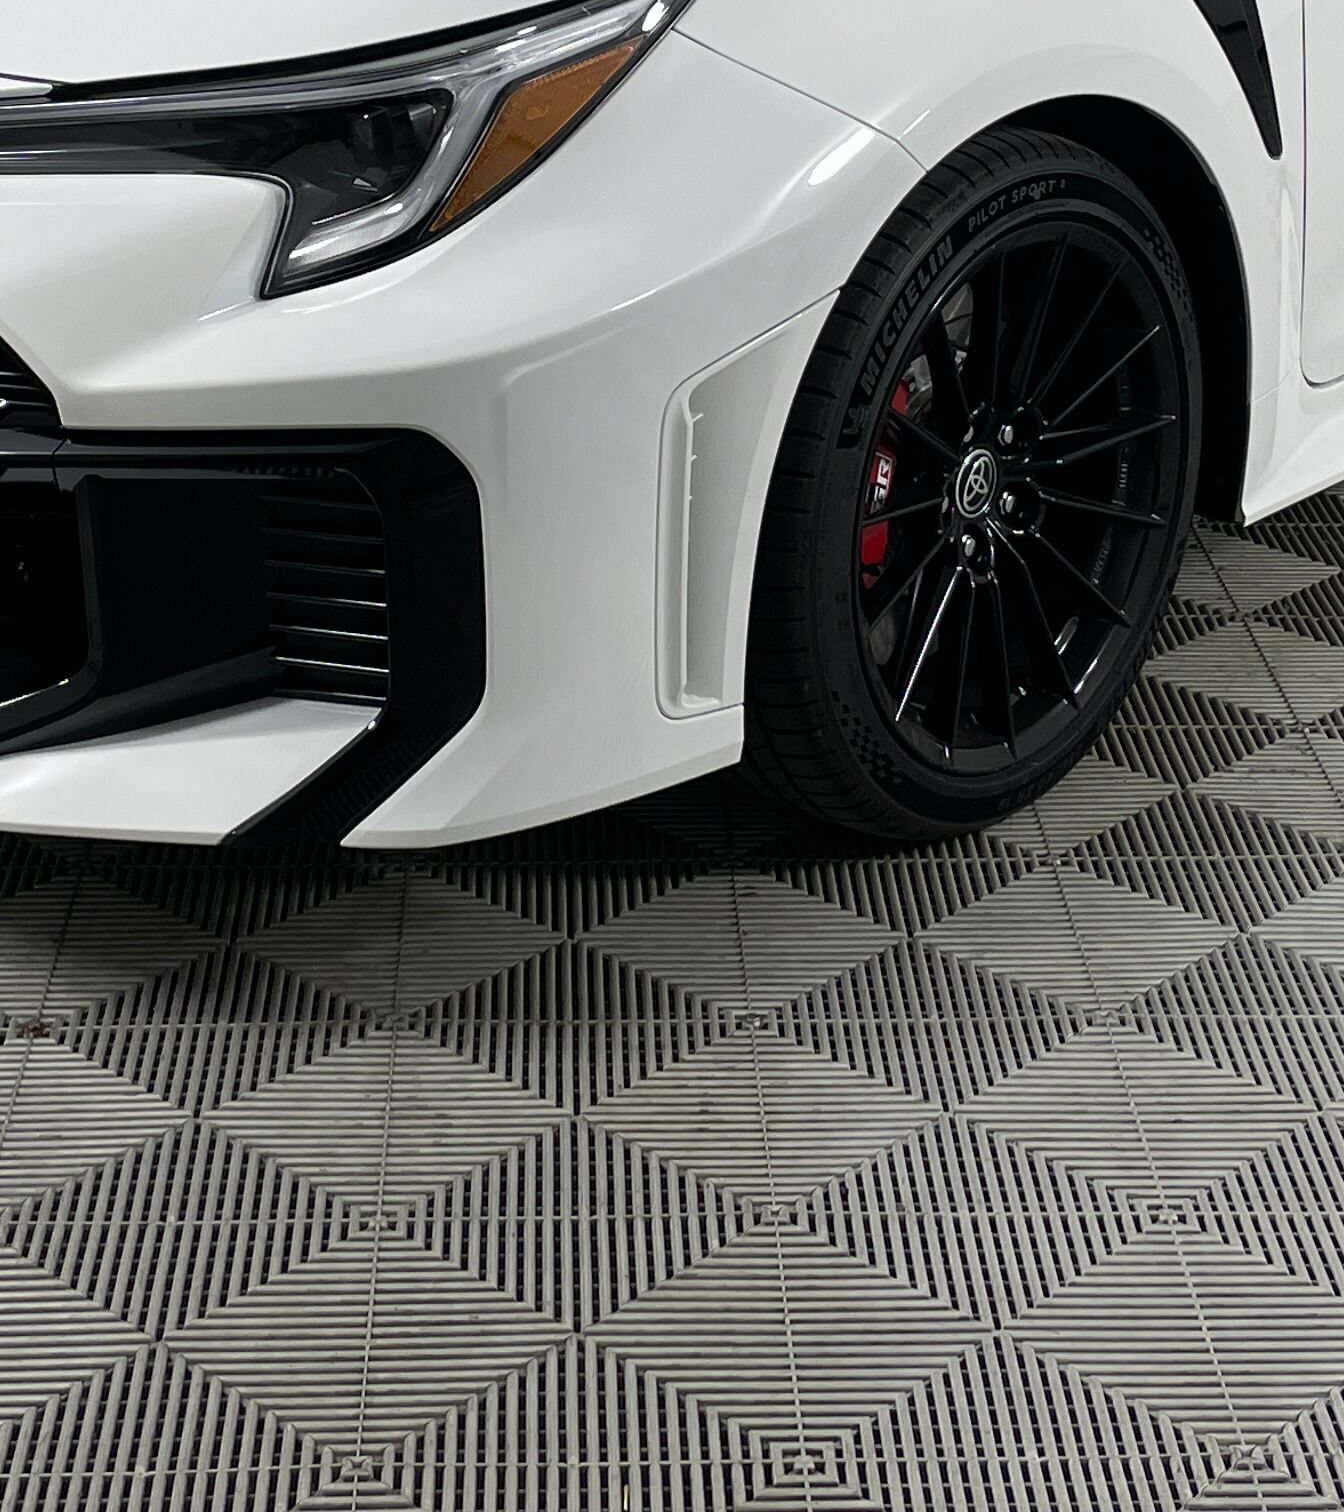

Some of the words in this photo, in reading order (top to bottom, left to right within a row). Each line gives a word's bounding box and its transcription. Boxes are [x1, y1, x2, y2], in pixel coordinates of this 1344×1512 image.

[968, 194, 1007, 233] PILOT
[1011, 179, 1057, 204] SPORT
[858, 235, 955, 396] MICHELIN
